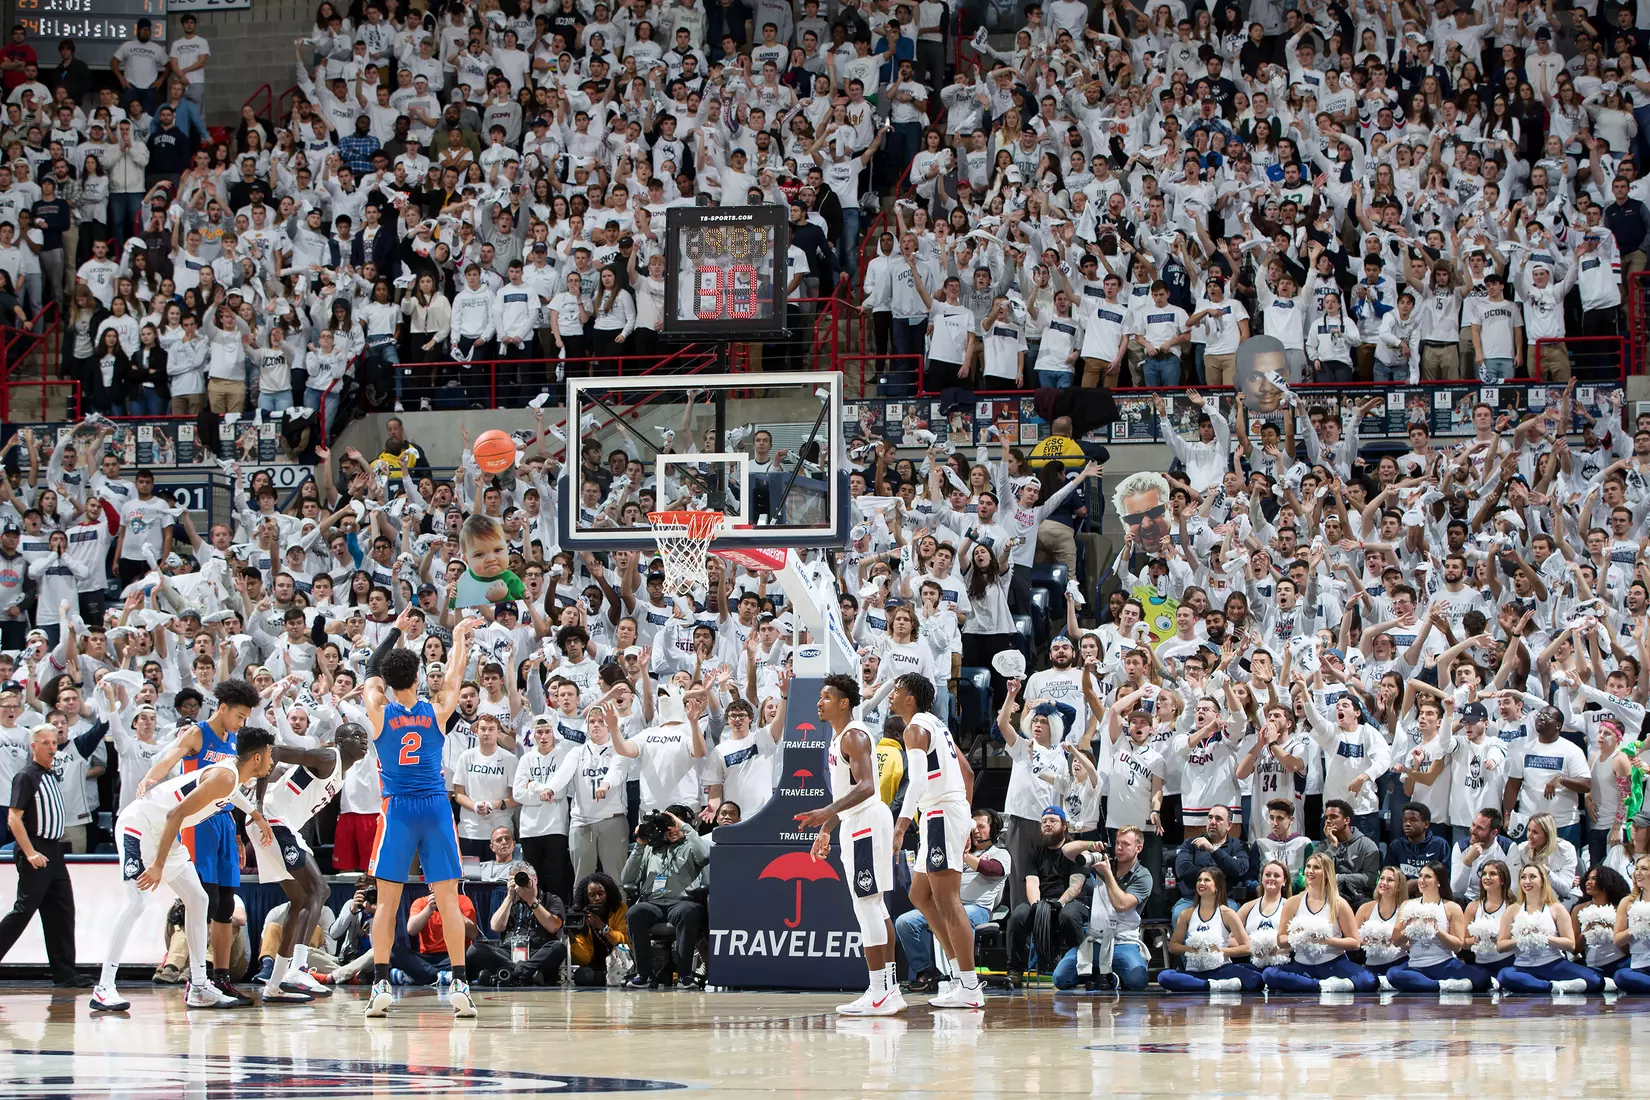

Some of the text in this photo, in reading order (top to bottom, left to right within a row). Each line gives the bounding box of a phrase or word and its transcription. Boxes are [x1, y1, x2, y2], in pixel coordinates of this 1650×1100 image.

[1173, 274, 1185, 287] 34
[694, 265, 757, 319] 30
[1484, 309, 1512, 319] UCONN
[1392, 394, 1400, 403] 31
[1439, 393, 1447, 402] 14
[1485, 389, 1494, 399] 23
[1206, 397, 1214, 406] 23
[891, 405, 898, 414] 32
[140, 427, 150, 436] 52
[181, 426, 191, 435] 42
[1045, 438, 1063, 446] CSC
[1043, 445, 1062, 454] EVENT
[388, 714, 433, 730] NEMBHARD
[1593, 712, 1616, 722] UCO
[646, 735, 682, 744] UCONN
[399, 731, 422, 766] 2
[783, 741, 826, 749] TRAVELERS
[1187, 752, 1214, 765] UCONN
[468, 764, 505, 775] UCONN
[1119, 752, 1152, 779] UCONN
[582, 766, 609, 778] UCONN
[1127, 769, 1135, 786] 3
[1263, 774, 1278, 793] 34
[1465, 777, 1485, 790] UCONN
[780, 788, 825, 797] TRAVELERS
[779, 832, 819, 841] TRAVELER
[709, 929, 865, 958] TRAVELER
